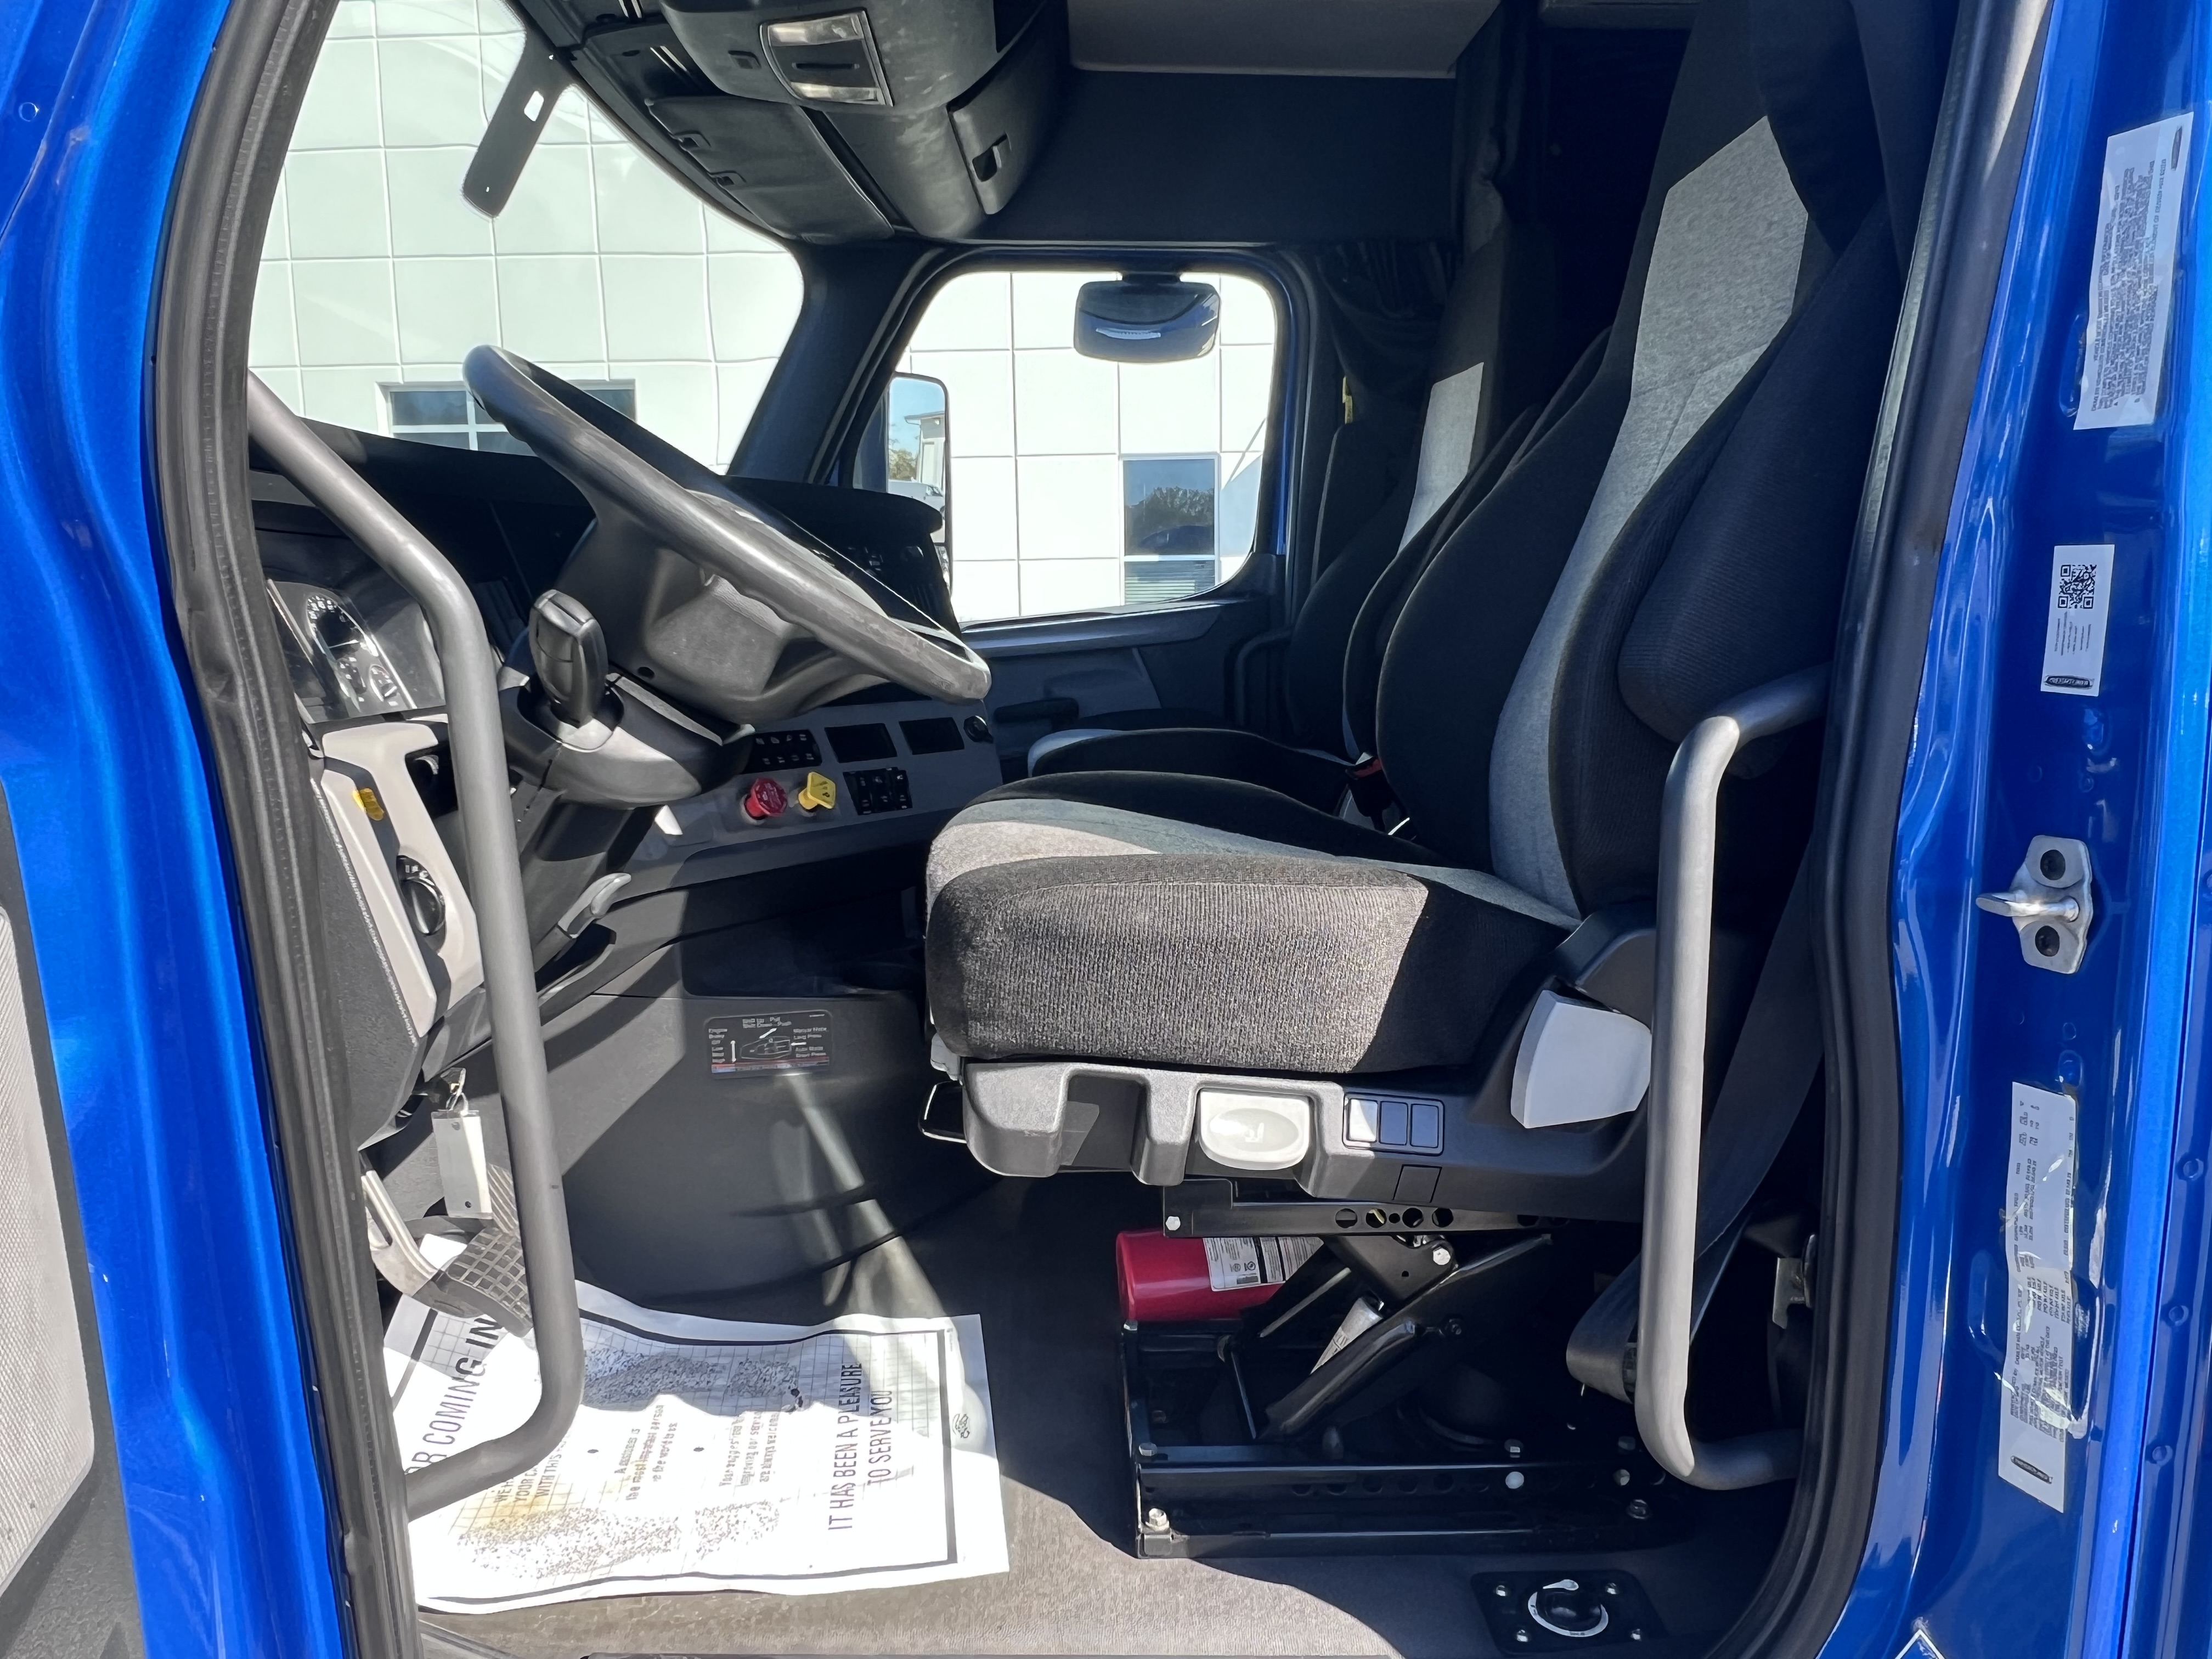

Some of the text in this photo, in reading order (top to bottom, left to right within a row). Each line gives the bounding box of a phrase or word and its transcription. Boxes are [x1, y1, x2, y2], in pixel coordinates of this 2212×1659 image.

[422, 1357, 487, 1444] COMING
[828, 1363, 861, 1530] IT HAS BEEN A PLEASURE
[867, 1390, 891, 1485] TO SERVE YOU
